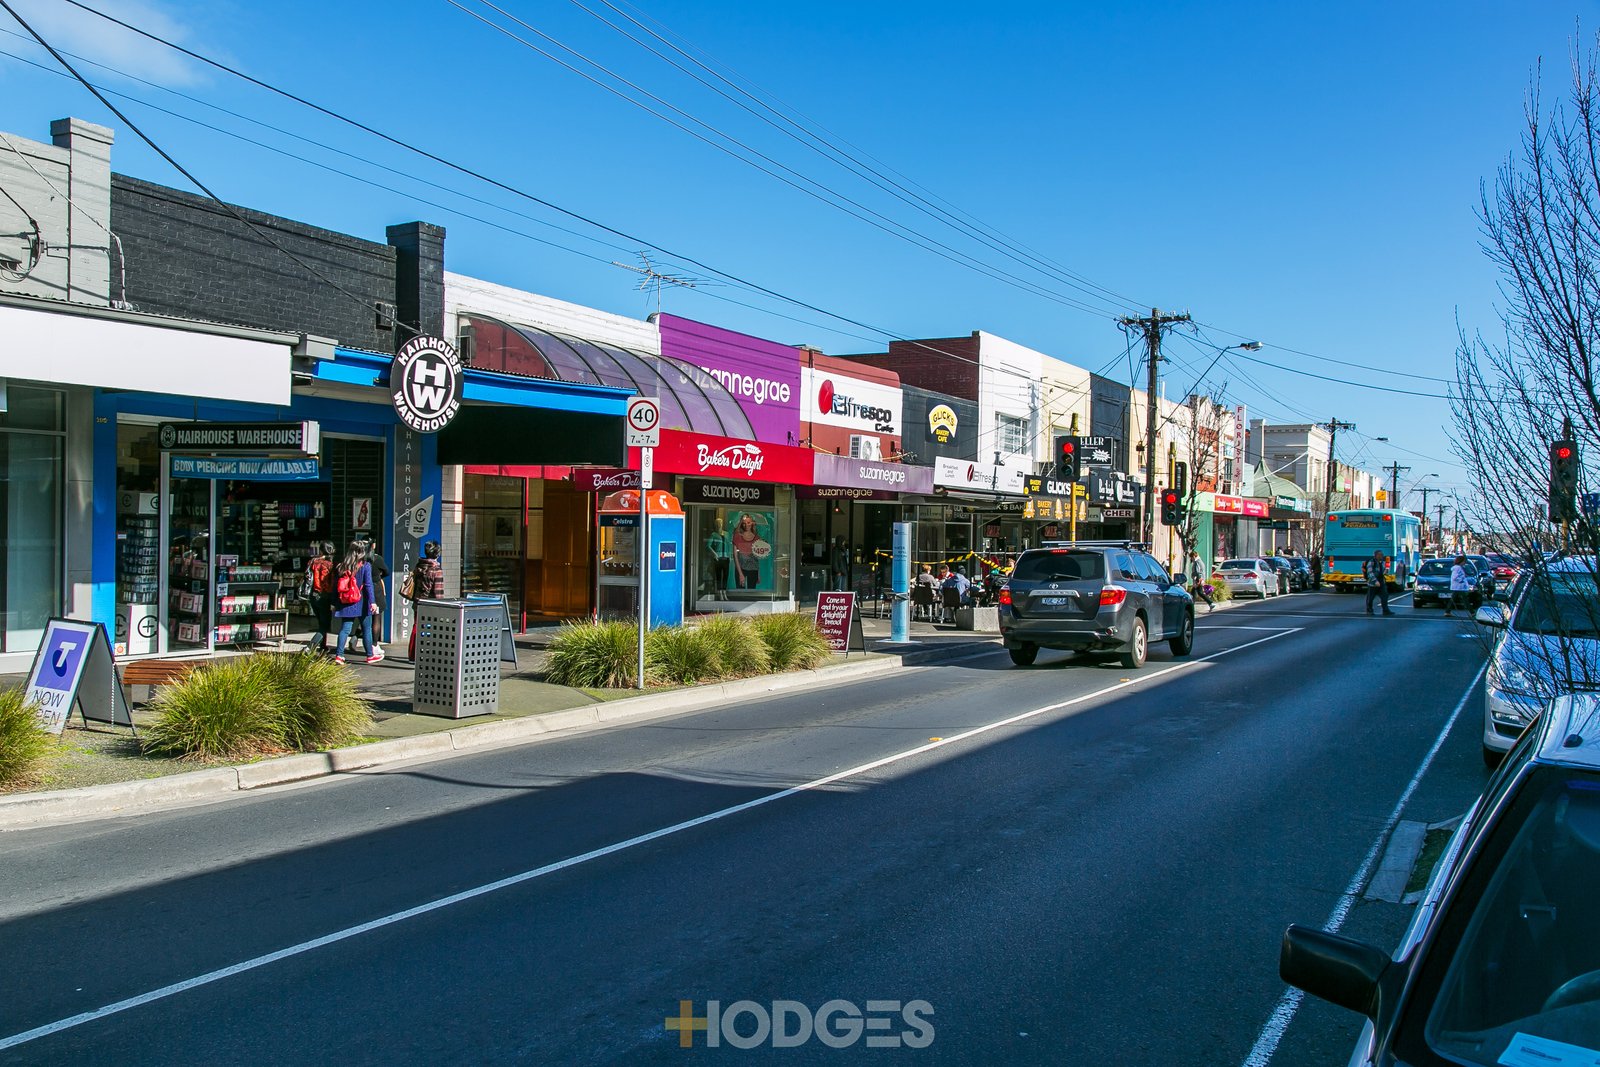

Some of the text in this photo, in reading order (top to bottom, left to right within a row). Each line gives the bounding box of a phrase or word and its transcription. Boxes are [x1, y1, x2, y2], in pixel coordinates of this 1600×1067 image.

[398, 337, 462, 375] HAIRHOUSE
[414, 360, 446, 387] H
[680, 364, 790, 404] suzannegrae
[412, 384, 446, 410] W
[394, 390, 460, 430] WAREHOUSE
[633, 408, 654, 422] 40
[177, 430, 234, 444] HAIRHOUSE
[236, 430, 302, 444] WAREHOUSE
[1080, 437, 1104, 446] ELLER
[174, 460, 316, 474] BODY PIERCING NOW AVAILABLE!
[697, 444, 764, 476] Bakers Delight
[592, 474, 620, 490] Bakers
[860, 466, 906, 485] suzannegrae
[702, 484, 760, 502] suzannegrae
[818, 488, 873, 498] suzannegrae
[1040, 508, 1050, 516] CAFE
[402, 542, 412, 638] WAREOUSE
[32, 690, 64, 708] NOW
